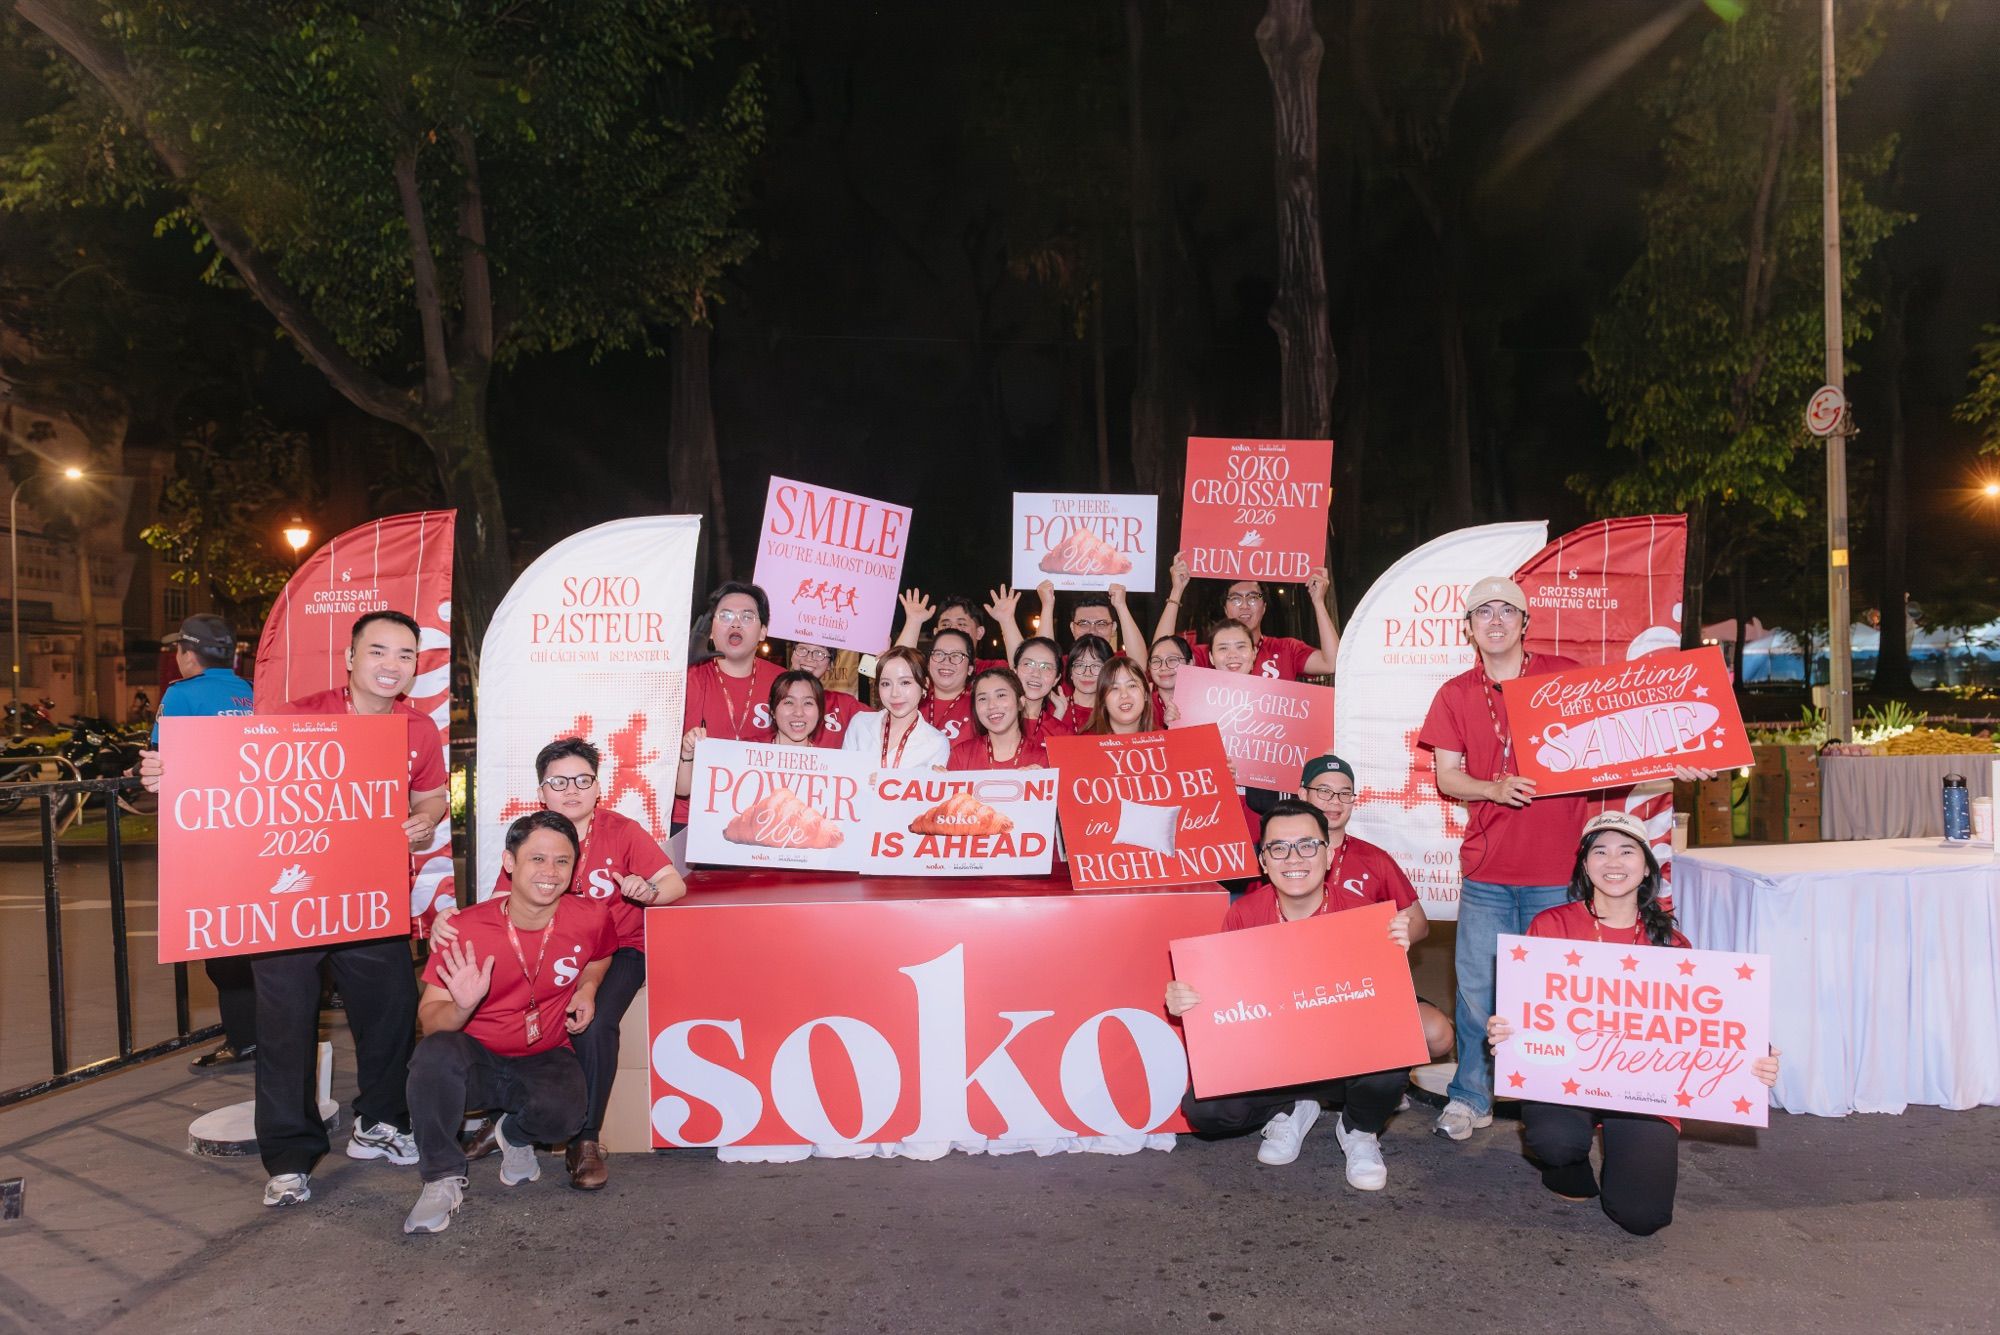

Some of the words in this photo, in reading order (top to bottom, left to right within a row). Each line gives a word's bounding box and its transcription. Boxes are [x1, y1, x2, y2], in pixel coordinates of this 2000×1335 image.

[1227, 455, 1289, 481] SOKO
[1052, 500, 1077, 512] TAP
[1078, 500, 1110, 514] HERE
[1192, 479, 1323, 508] CROISSANT
[770, 485, 903, 560] SMILE
[1233, 508, 1276, 526] 2026
[1024, 515, 1146, 554] POWER
[767, 540, 813, 564] YOU'RE
[814, 551, 864, 572] ALMOST
[864, 561, 896, 580] DONE
[1192, 547, 1241, 574] RUN
[1249, 552, 1311, 578] CLUB
[314, 589, 380, 602] CROISSANT
[562, 576, 641, 607] SOKO
[1414, 584, 1470, 613] SOK
[1530, 596, 1584, 609] RUNNING
[1587, 598, 1618, 610] CLUB
[1539, 586, 1608, 598] CROISSANT
[305, 601, 356, 615] RUNNING
[358, 600, 388, 613] CLUB
[530, 612, 664, 644] PASTEUR
[1384, 618, 1471, 647] PASTE
[626, 649, 670, 662] PASTEUR
[1206, 686, 1253, 706] COOL
[1260, 694, 1310, 720] GIRLS
[1530, 662, 1698, 716] Regretting
[1560, 700, 1594, 717] LIFE
[1596, 685, 1675, 714] CHOICES?
[244, 722, 279, 735] soko.
[1216, 698, 1287, 740] Run
[238, 740, 346, 784] SOKO
[746, 748, 775, 767] TAP
[777, 752, 818, 770] HERE
[819, 762, 829, 771] to
[1106, 747, 1168, 776] YOU
[1223, 735, 1310, 768] RATHON
[1073, 773, 1172, 806] COULD
[1176, 768, 1218, 798] BE
[1592, 772, 1622, 783] soko.
[174, 780, 400, 831] CROISSANT
[704, 765, 862, 823] POWER
[936, 812, 980, 826] soko.
[1085, 818, 1112, 836] in
[1180, 800, 1221, 832] bed
[258, 827, 330, 858] 2026
[870, 831, 905, 858] IS
[912, 832, 1047, 858] AHEAD
[1424, 850, 1453, 865] 6:00
[1074, 847, 1176, 883] RIGHT
[1177, 841, 1247, 876] NOW
[1428, 869, 1452, 884] ALL
[1428, 887, 1460, 902] MAD
[185, 901, 280, 951] RUN
[291, 890, 392, 940] CLUB
[1214, 1000, 1272, 1025] soko.
[1296, 988, 1376, 1010] MARATHON
[1545, 972, 1724, 1014] RUNNING
[1522, 1002, 1555, 1032] IS
[1566, 1008, 1747, 1050] CHEAPER
[651, 942, 1189, 1148] soko
[1524, 1042, 1566, 1057] THAN
[1575, 1029, 1744, 1098] Therapy
[1584, 1088, 1612, 1098] soko.
